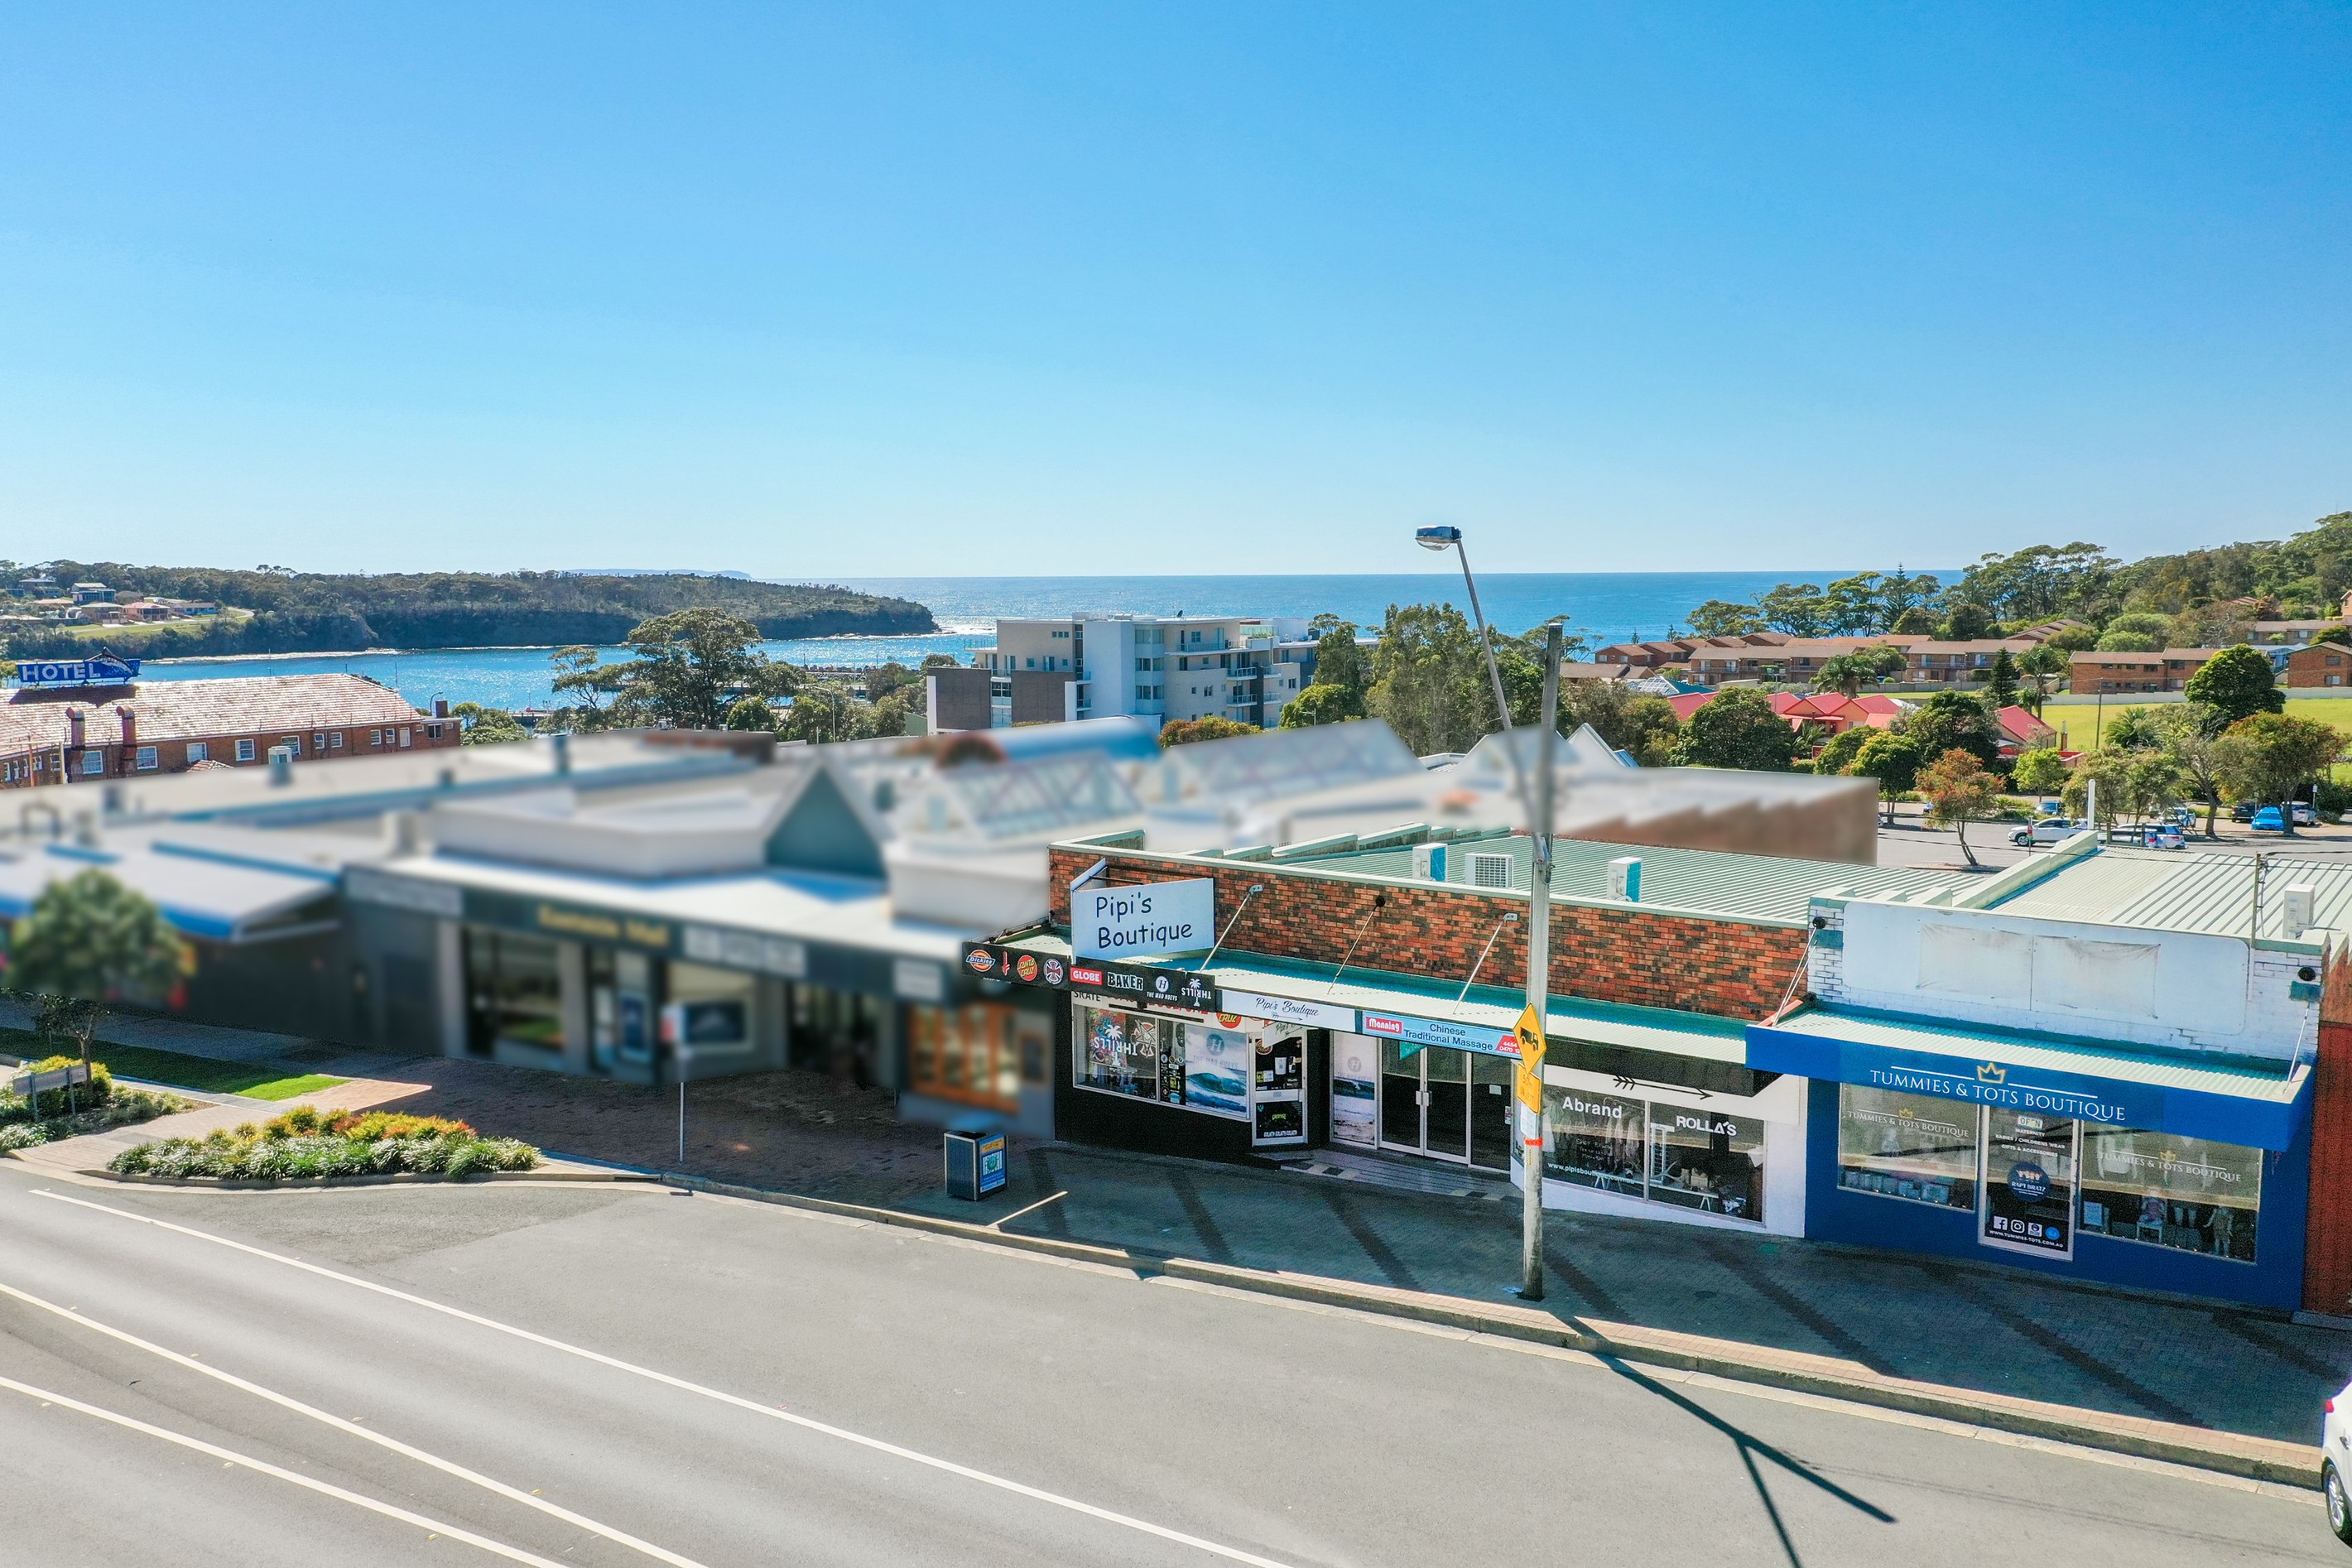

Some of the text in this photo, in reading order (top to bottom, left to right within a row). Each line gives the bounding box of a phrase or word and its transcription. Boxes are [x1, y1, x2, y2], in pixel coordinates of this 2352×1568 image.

[22, 662, 101, 681] HOTEL
[1095, 892, 1152, 923] Pipi's
[1098, 922, 1193, 949] Boutique
[969, 955, 993, 964] Dickies
[1018, 957, 1035, 969] SANTA
[1020, 968, 1035, 977] CRUZ
[1073, 969, 1100, 983] GLOBE
[1108, 971, 1144, 992] BAKER
[1074, 992, 1101, 1002] SKATE
[1181, 987, 1212, 999] THRILLS
[1256, 997, 1320, 1018] Pipi's Boutique
[1219, 1013, 1238, 1023] CRUZ
[1368, 1017, 1400, 1032] Manning
[1429, 1023, 1466, 1037] Chinese
[1094, 1036, 1138, 1056] THRILLS
[1403, 1029, 1493, 1051] Traditional Massage
[1870, 1070, 2126, 1122] TUMMIES & TOTS BOUTIQUE
[1562, 1096, 1623, 1118] Abrand
[1676, 1115, 1737, 1137] ROLLA'S
[1848, 1110, 1888, 1123] TUMMIES
[1897, 1119, 1920, 1130] TOTS
[1922, 1123, 1970, 1138] BOUTIQUE
[2020, 1117, 2041, 1128] OPN
[2147, 1160, 2155, 1168] &
[2157, 1162, 2183, 1172] TOTS
[2186, 1166, 2242, 1182] BOUTIQUE
